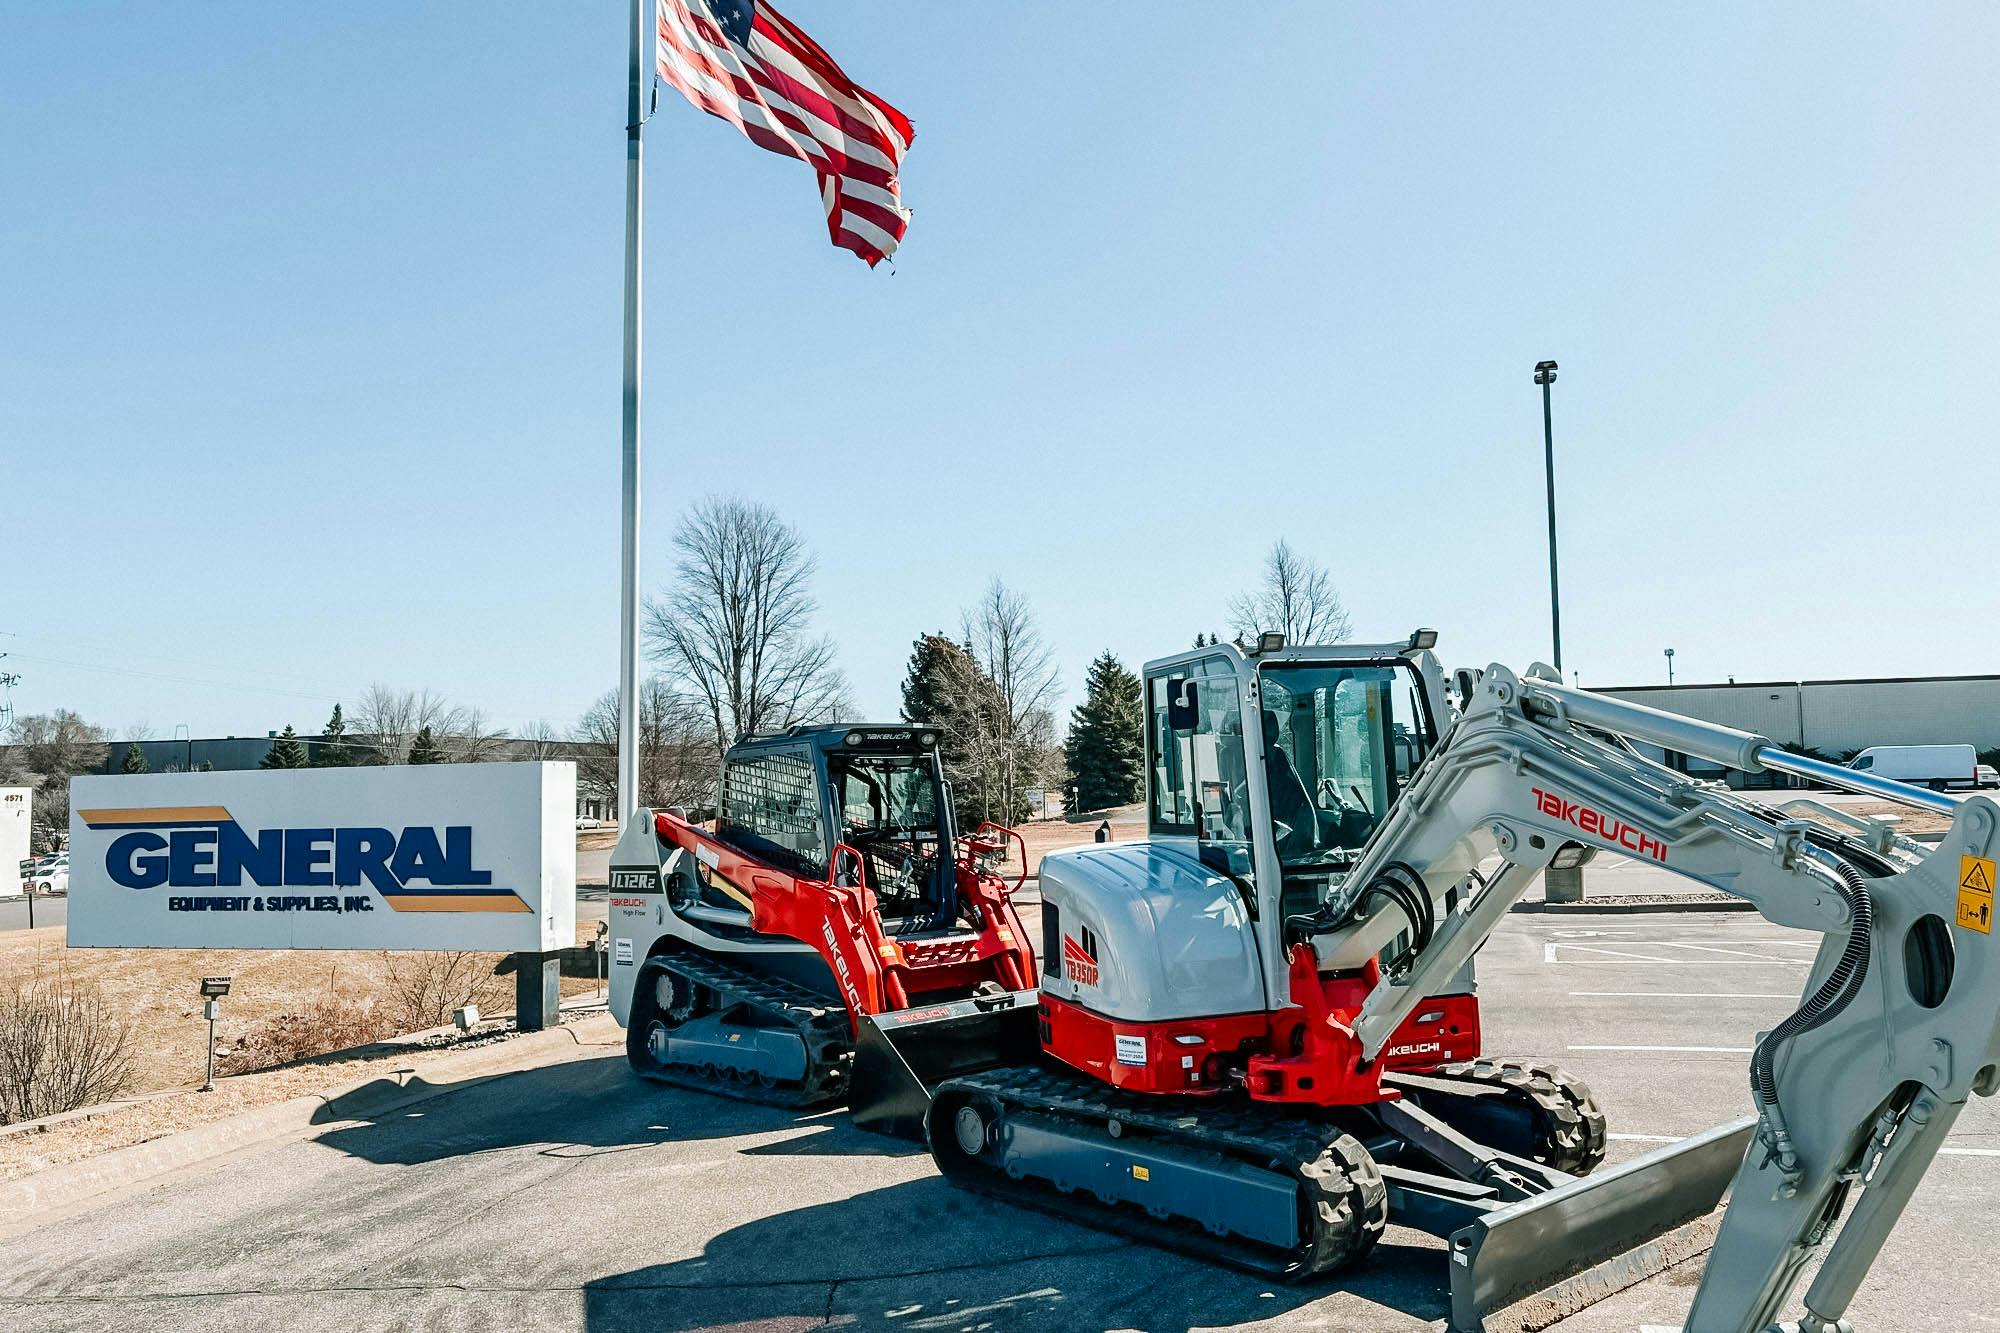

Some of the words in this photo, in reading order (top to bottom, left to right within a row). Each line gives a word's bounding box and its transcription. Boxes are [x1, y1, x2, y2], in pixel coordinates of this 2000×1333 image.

[106, 826, 492, 890] GENERAL
[611, 871, 656, 888] TL12R2
[169, 896, 250, 911] EQUIPMENT
[253, 896, 264, 911] &
[267, 896, 342, 914] SUPPLIES,
[344, 896, 374, 912] INC.
[1065, 960, 1099, 988] TB350R
